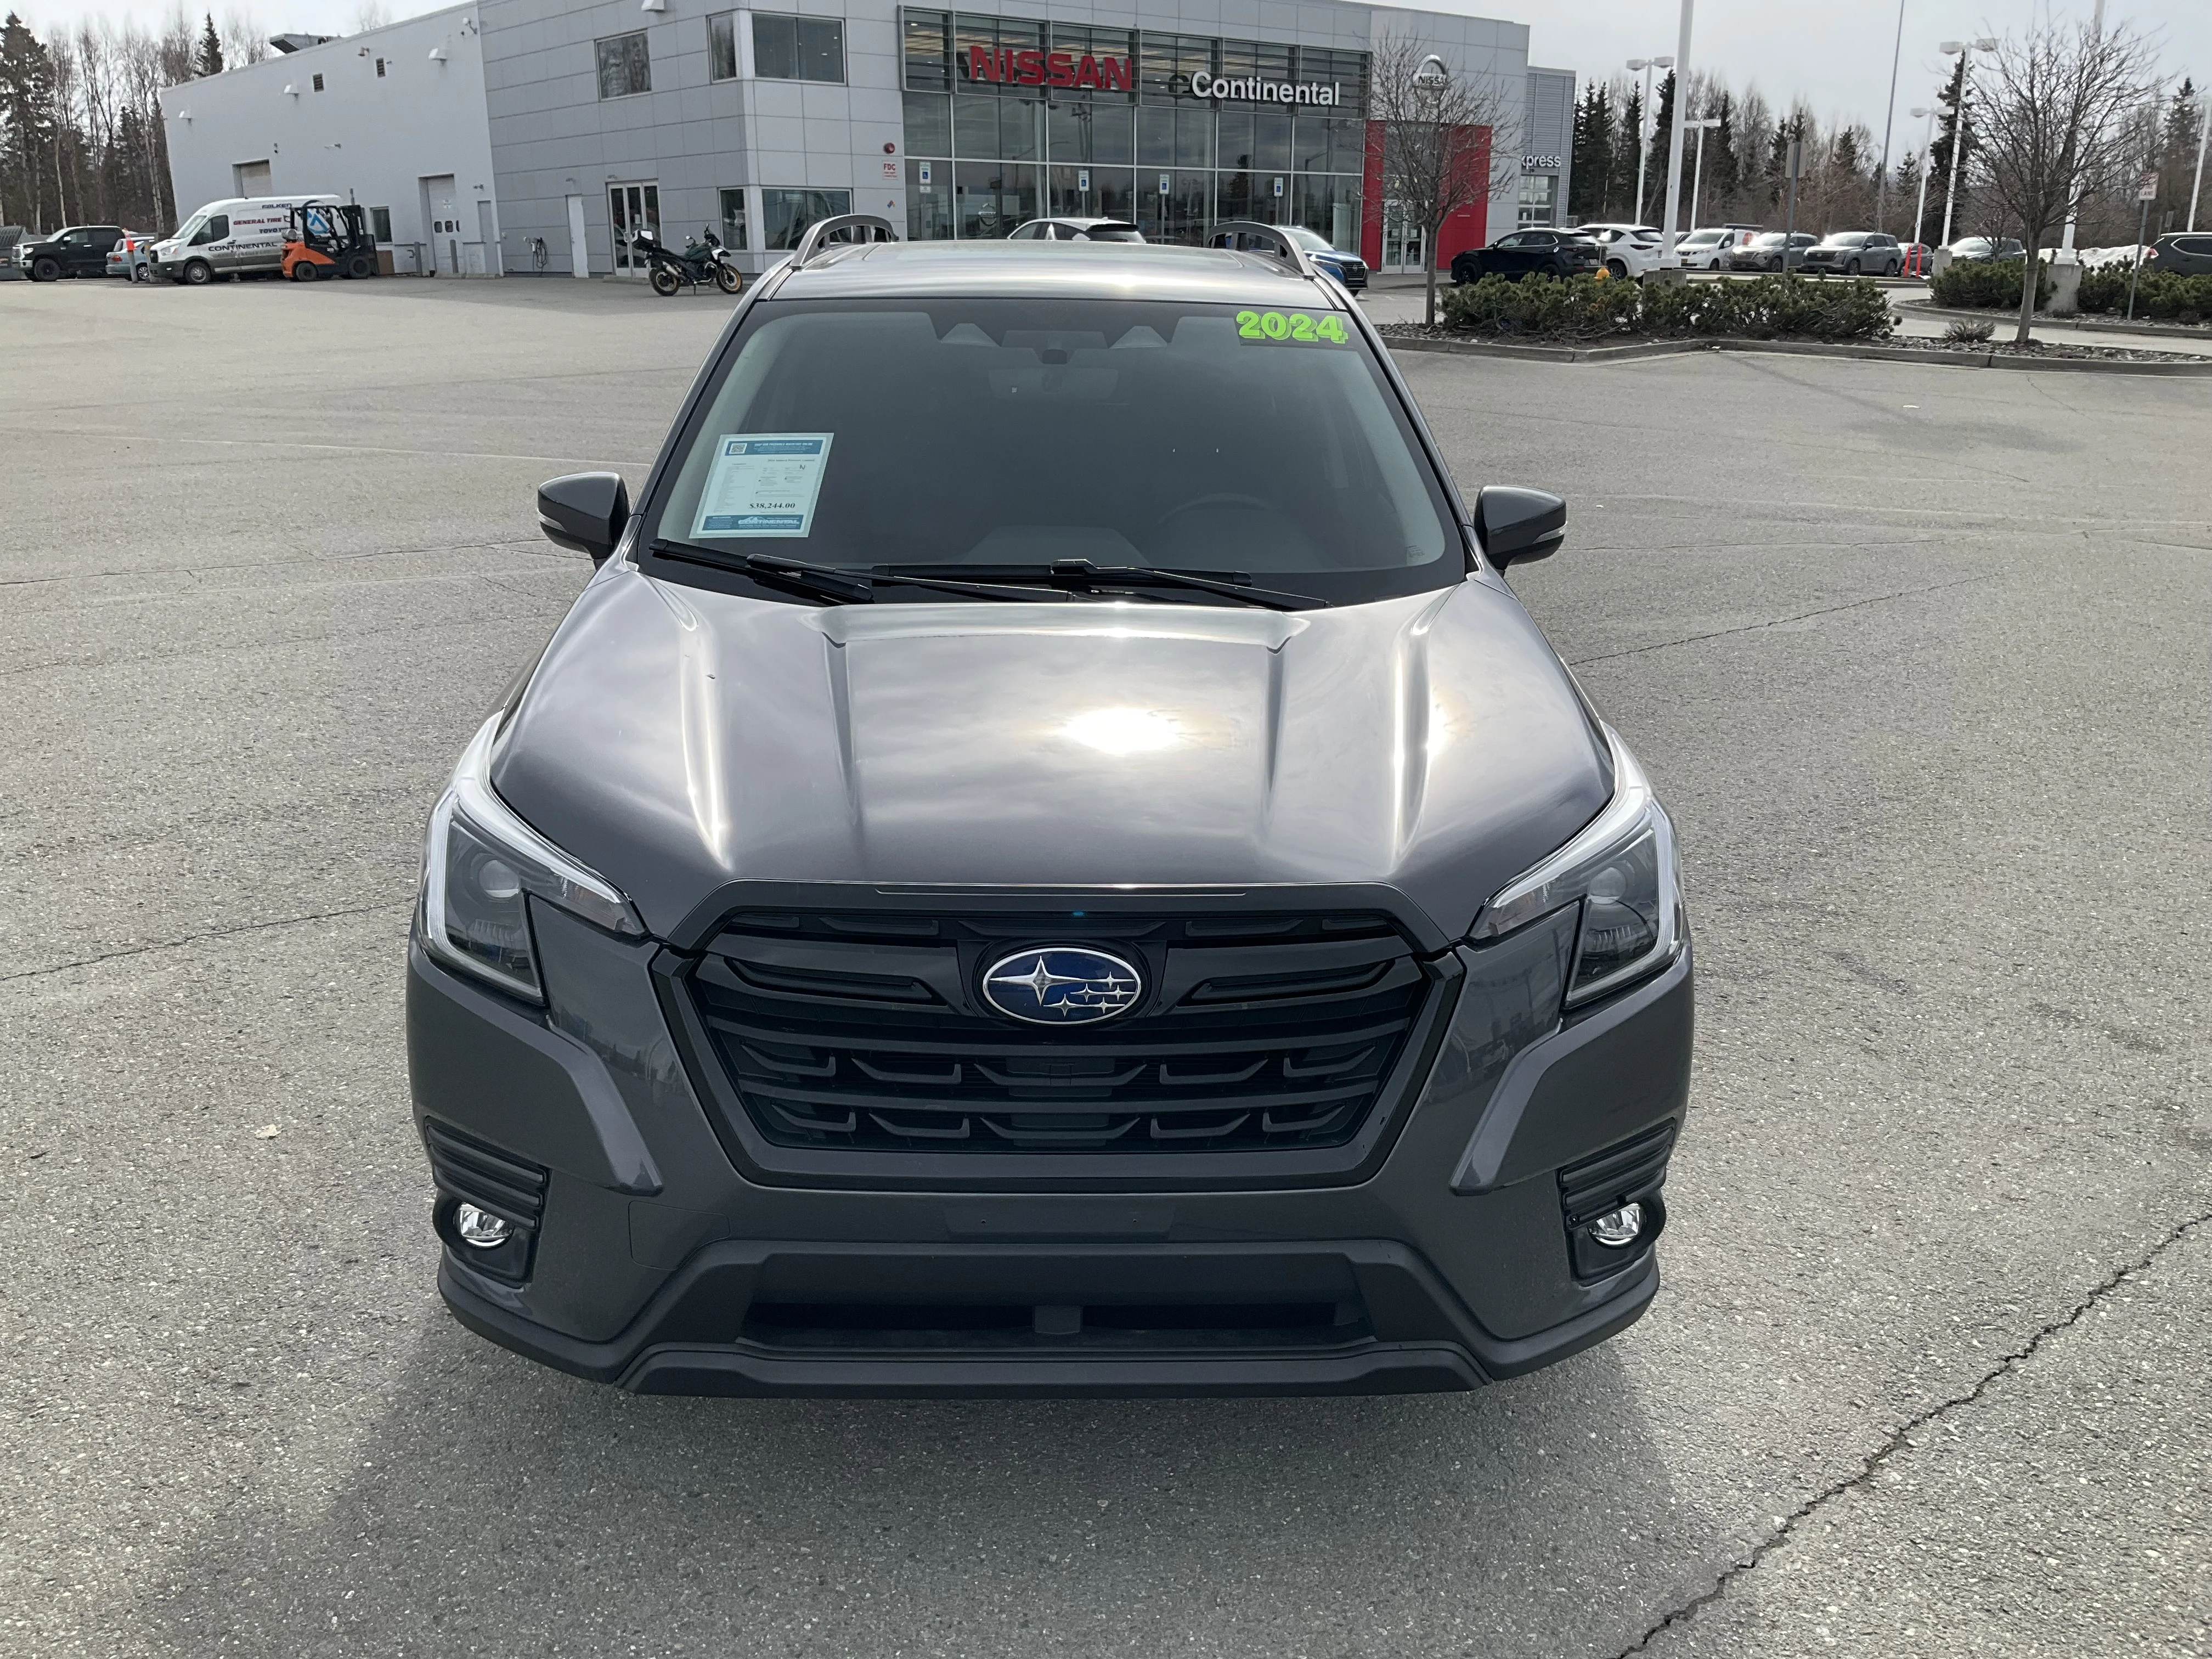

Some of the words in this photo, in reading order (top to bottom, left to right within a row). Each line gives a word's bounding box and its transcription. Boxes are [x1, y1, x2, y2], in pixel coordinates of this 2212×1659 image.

[969, 46, 1132, 91] NISSAN
[1191, 71, 1340, 106] Continental
[208, 242, 278, 252] CONTINENTAL
[1236, 311, 1348, 344] 2024
